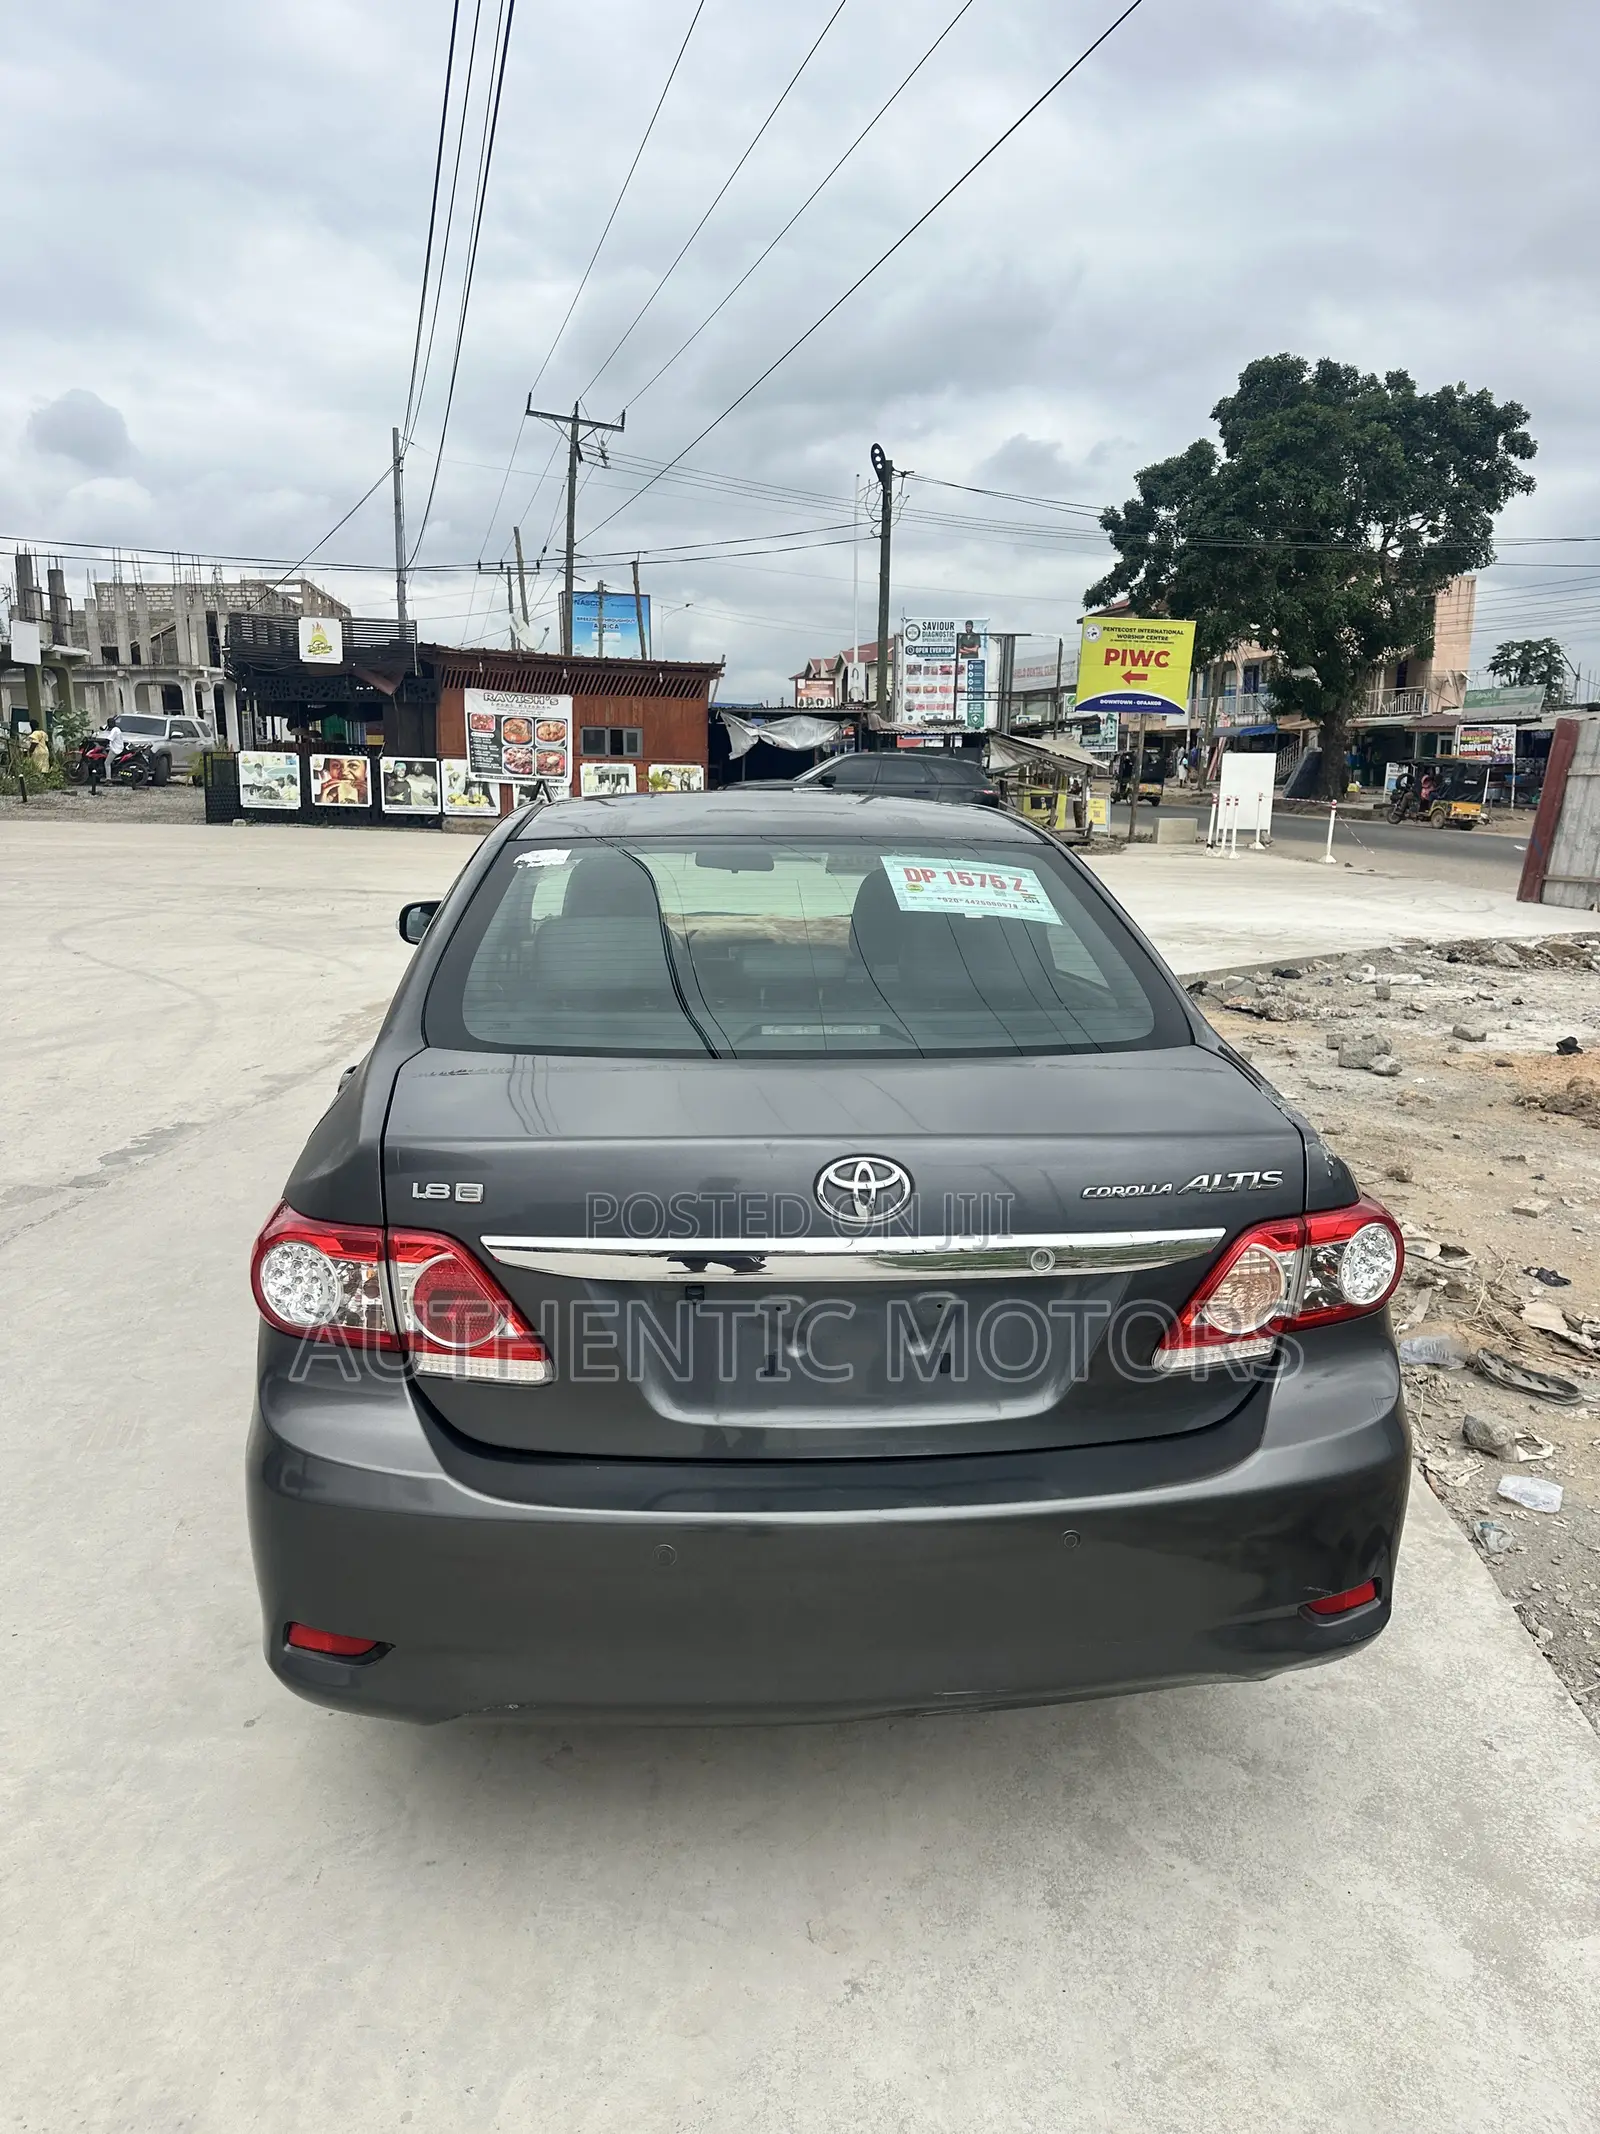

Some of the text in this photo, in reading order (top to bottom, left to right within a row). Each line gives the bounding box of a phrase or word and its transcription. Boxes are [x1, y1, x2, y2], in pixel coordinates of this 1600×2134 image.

[922, 621, 955, 631] SAVIOUR
[1104, 648, 1171, 668] PIWC
[903, 868, 1028, 892] DP 1575 Z
[1082, 1170, 1284, 1199] COROLLA ALTIS
